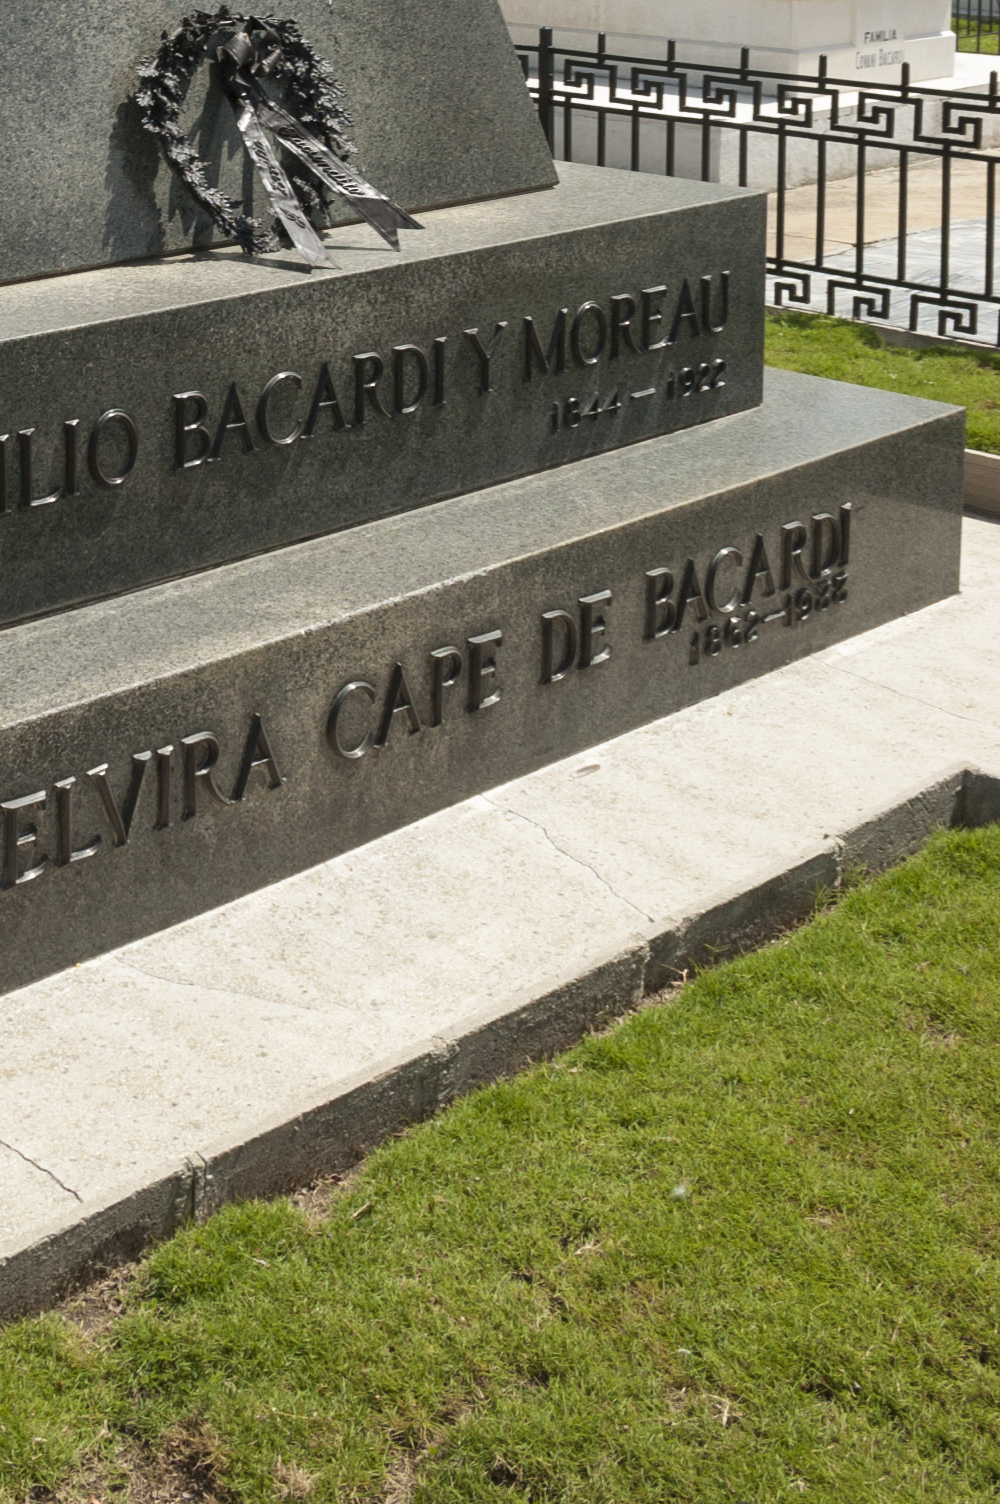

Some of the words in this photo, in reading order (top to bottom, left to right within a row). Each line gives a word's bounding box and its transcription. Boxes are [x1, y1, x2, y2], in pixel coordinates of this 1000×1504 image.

[864, 29, 897, 44] FAMILIA
[279, 125, 365, 196] Facundito
[173, 337, 447, 469] BACARDI
[463, 321, 507, 392] Y
[523, 270, 730, 383] MOREAU
[550, 386, 622, 433] 1844
[666, 358, 727, 400] 1922
[326, 629, 503, 760] CAPE
[541, 589, 613, 685] DE
[643, 502, 853, 641] BACARDI
